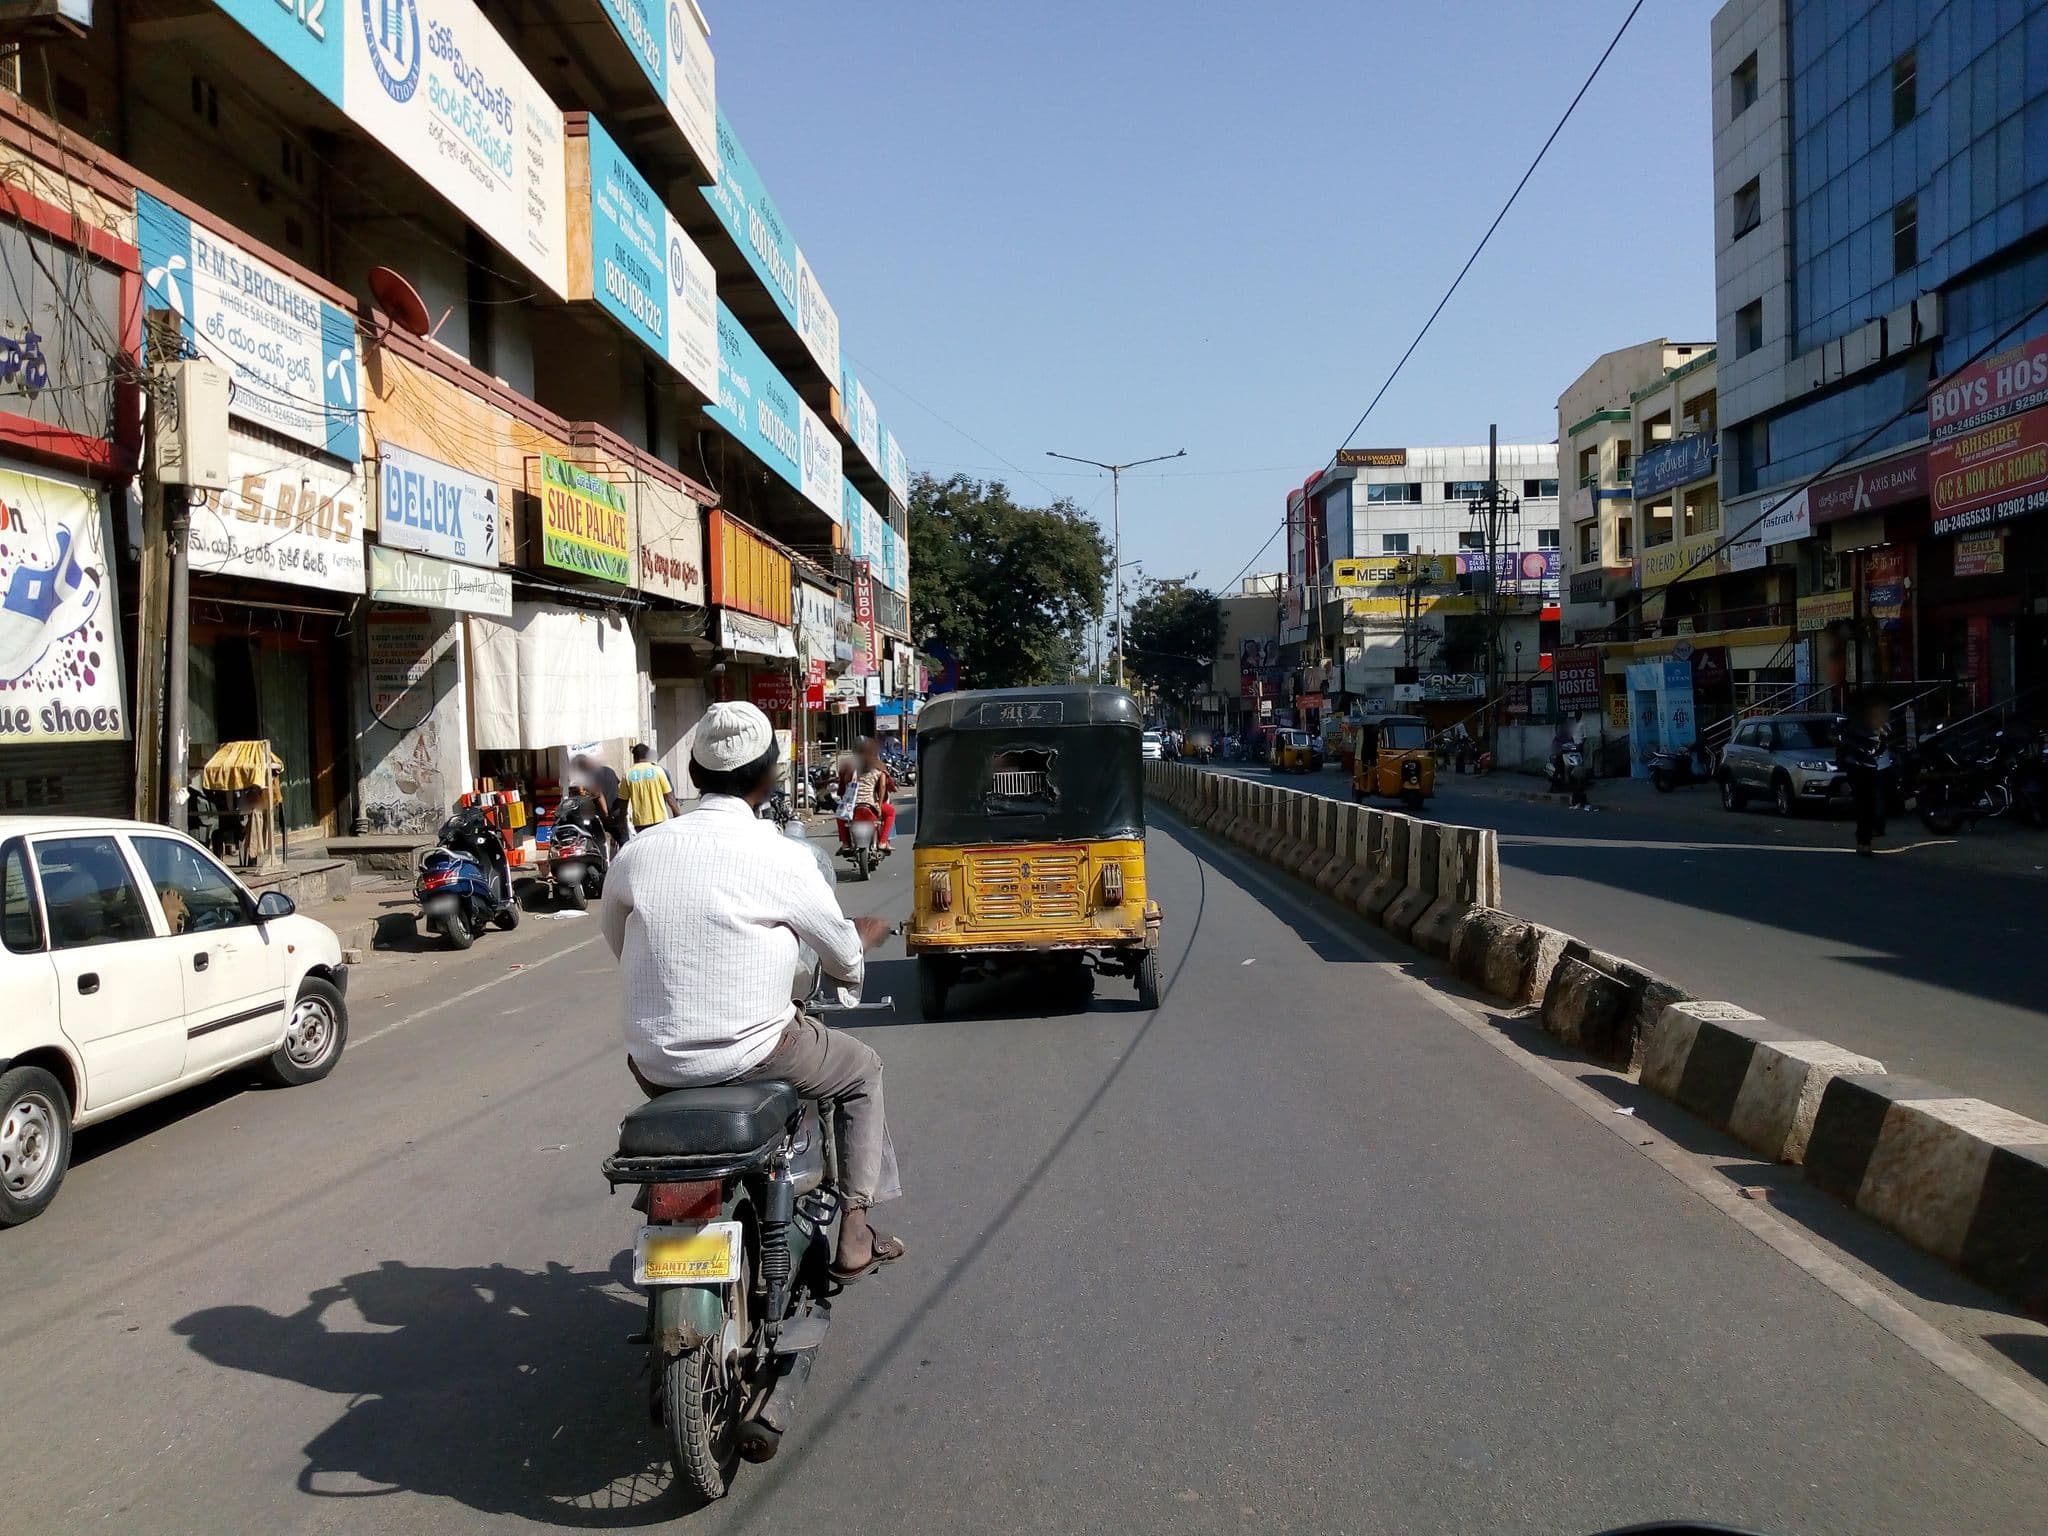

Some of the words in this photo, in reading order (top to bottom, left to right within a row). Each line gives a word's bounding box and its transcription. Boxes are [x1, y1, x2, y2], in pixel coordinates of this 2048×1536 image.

[748, 203, 767, 264] 1800
[197, 236, 208, 271] R
[213, 245, 225, 281] M
[230, 257, 240, 289] S
[243, 261, 318, 331] BROTHERS
[604, 257, 627, 302] 1800
[628, 278, 644, 321] 108
[644, 295, 663, 340] 1212
[206, 311, 225, 341] ఆర్
[1932, 377, 1988, 422] BOYS
[1955, 420, 2022, 459] ABHISHREY
[1869, 474, 1890, 493] AXIS
[1891, 467, 1917, 487] BANK
[1939, 478, 1954, 505] A/C
[1966, 469, 1986, 496] NON
[1988, 462, 2005, 490] A/C
[2008, 449, 2047, 483] ROOMS
[385, 463, 464, 539] DELUX
[548, 487, 583, 537] SHOE
[585, 502, 626, 550] PALACE
[1763, 511, 1794, 528] fastrack
[1934, 507, 1991, 535] 040-24655633
[1997, 497, 2025, 518] 92902
[1357, 568, 1396, 581] MESS
[1647, 549, 1683, 574] FRIEND'S
[1688, 543, 1713, 566] WEAR
[394, 560, 442, 602] Delux
[860, 620, 875, 671] XEROX
[1559, 679, 1598, 695] HOSTEL
[1560, 669, 1595, 679] BOYS
[41, 698, 120, 735] shoes
[648, 1262, 687, 1271] SHANTI
[689, 1261, 709, 1270] TVS
